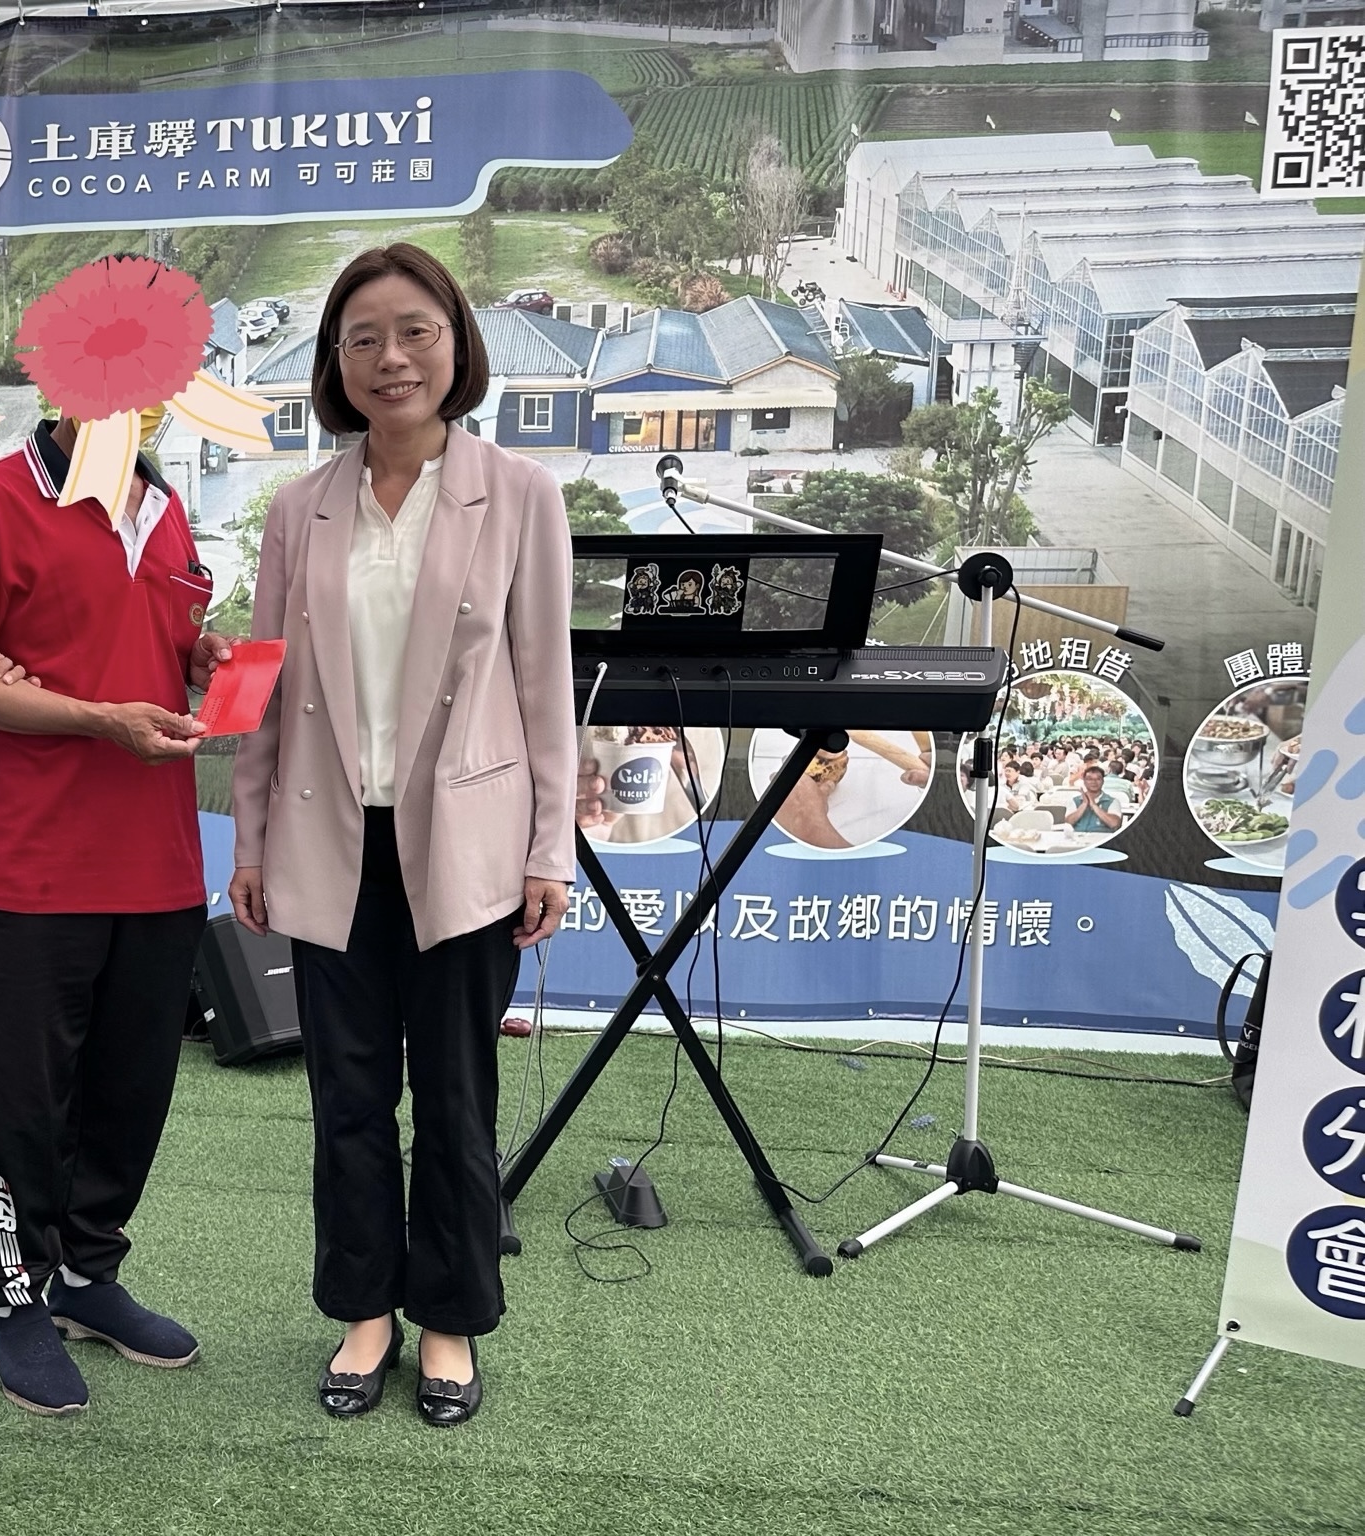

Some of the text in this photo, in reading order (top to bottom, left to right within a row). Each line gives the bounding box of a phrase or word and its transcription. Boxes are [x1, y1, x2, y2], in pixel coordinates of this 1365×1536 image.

[27, 118, 198, 164] 土庫驛
[28, 157, 433, 199] COCOA FARM 可可莊園
[608, 445, 660, 453] CHOCOLATE
[851, 669, 986, 681] PSR-SX920
[1223, 641, 1313, 688] 團體
